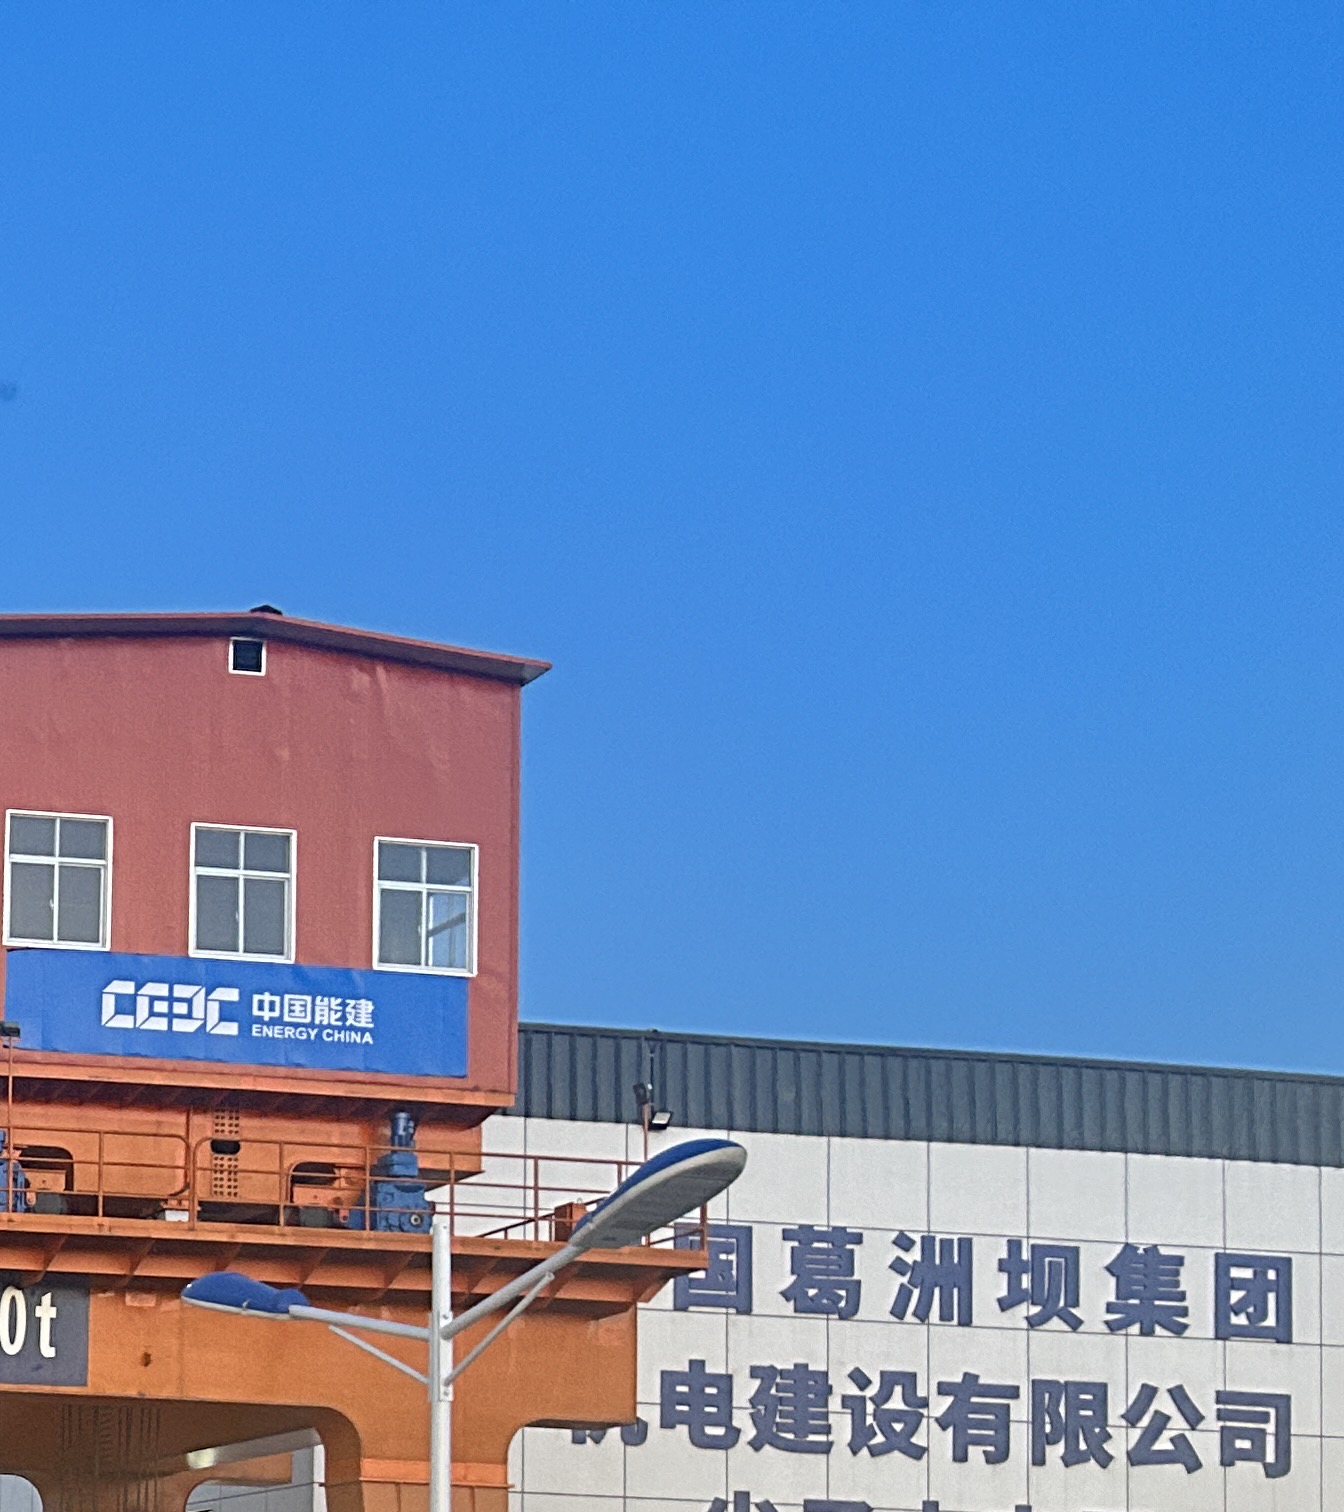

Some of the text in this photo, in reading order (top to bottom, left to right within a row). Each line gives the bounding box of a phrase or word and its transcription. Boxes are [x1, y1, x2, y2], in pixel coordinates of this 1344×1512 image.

[251, 991, 375, 1028] 中国能建
[251, 1023, 374, 1045] ENERGY CHINA
[570, 1358, 1293, 1480] 电建设有限公司
